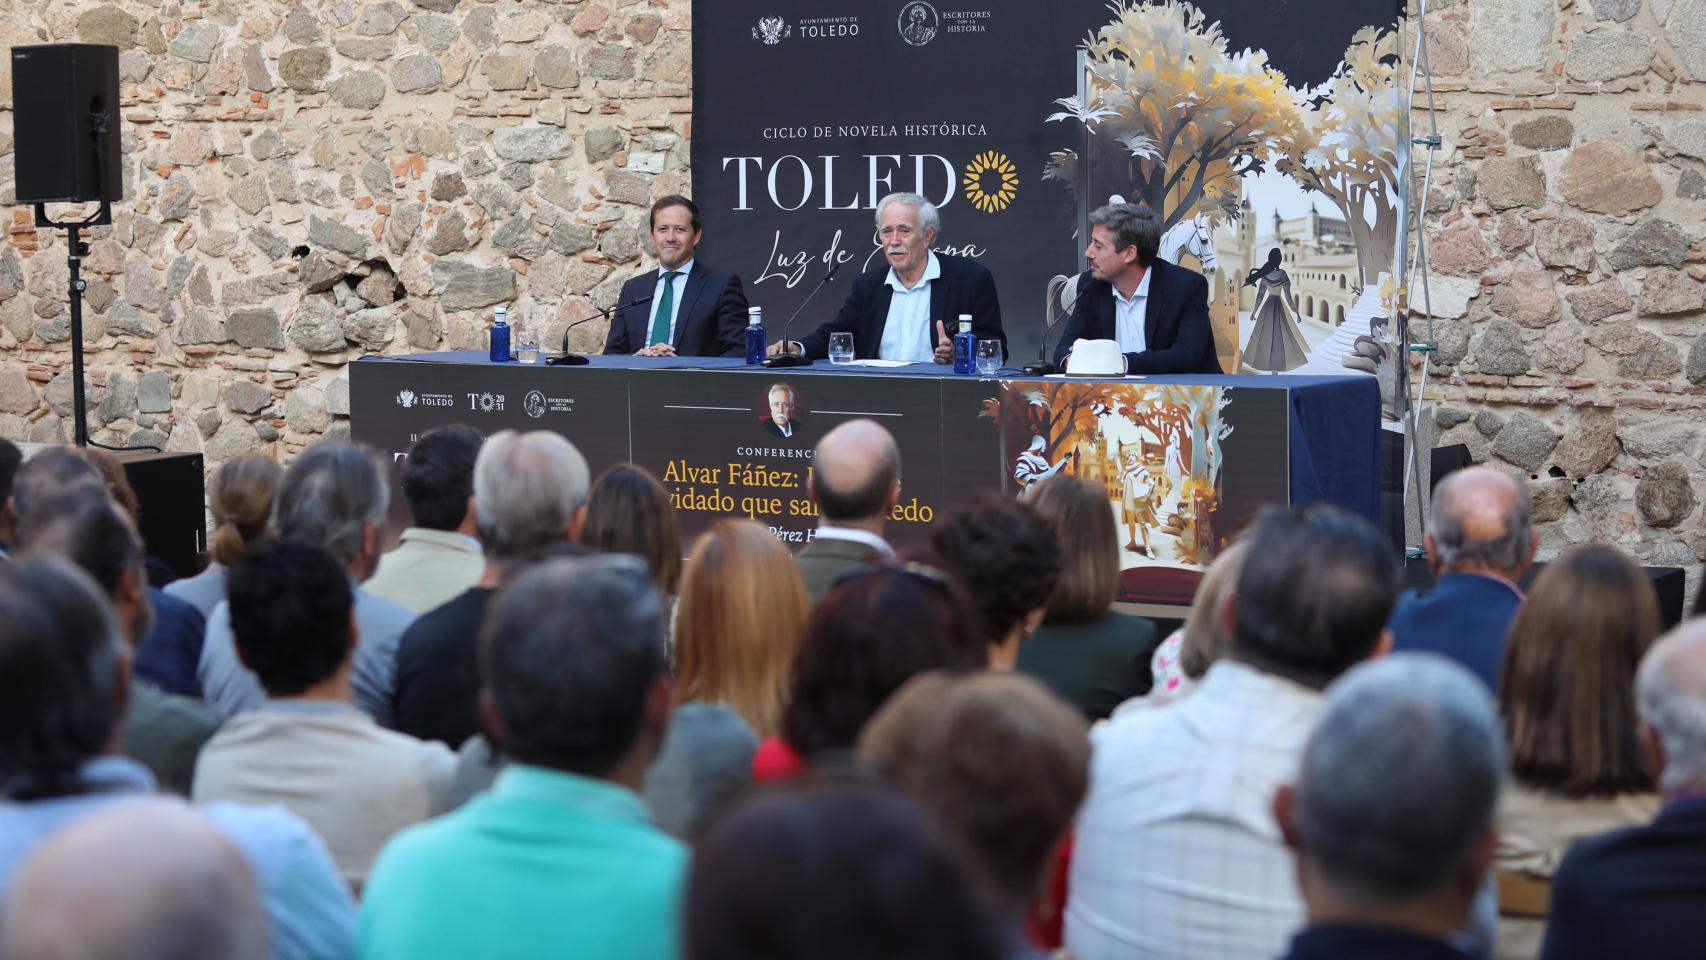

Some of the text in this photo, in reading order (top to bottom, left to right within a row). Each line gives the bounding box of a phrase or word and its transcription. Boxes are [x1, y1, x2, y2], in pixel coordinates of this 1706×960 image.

[943, 11, 991, 19] ESCRITORES
[800, 24, 859, 38] TOLEDO
[763, 121, 987, 139] CICLO DE NOVELA HISTÓRICA
[754, 230, 815, 289] Luz
[823, 229, 854, 281] de
[422, 398, 454, 406] TOLEDO
[495, 403, 504, 411] 31
[663, 460, 721, 484] Alvar
[728, 463, 799, 488] Fáñez:
[741, 496, 782, 520] que
[886, 498, 933, 522] edo
